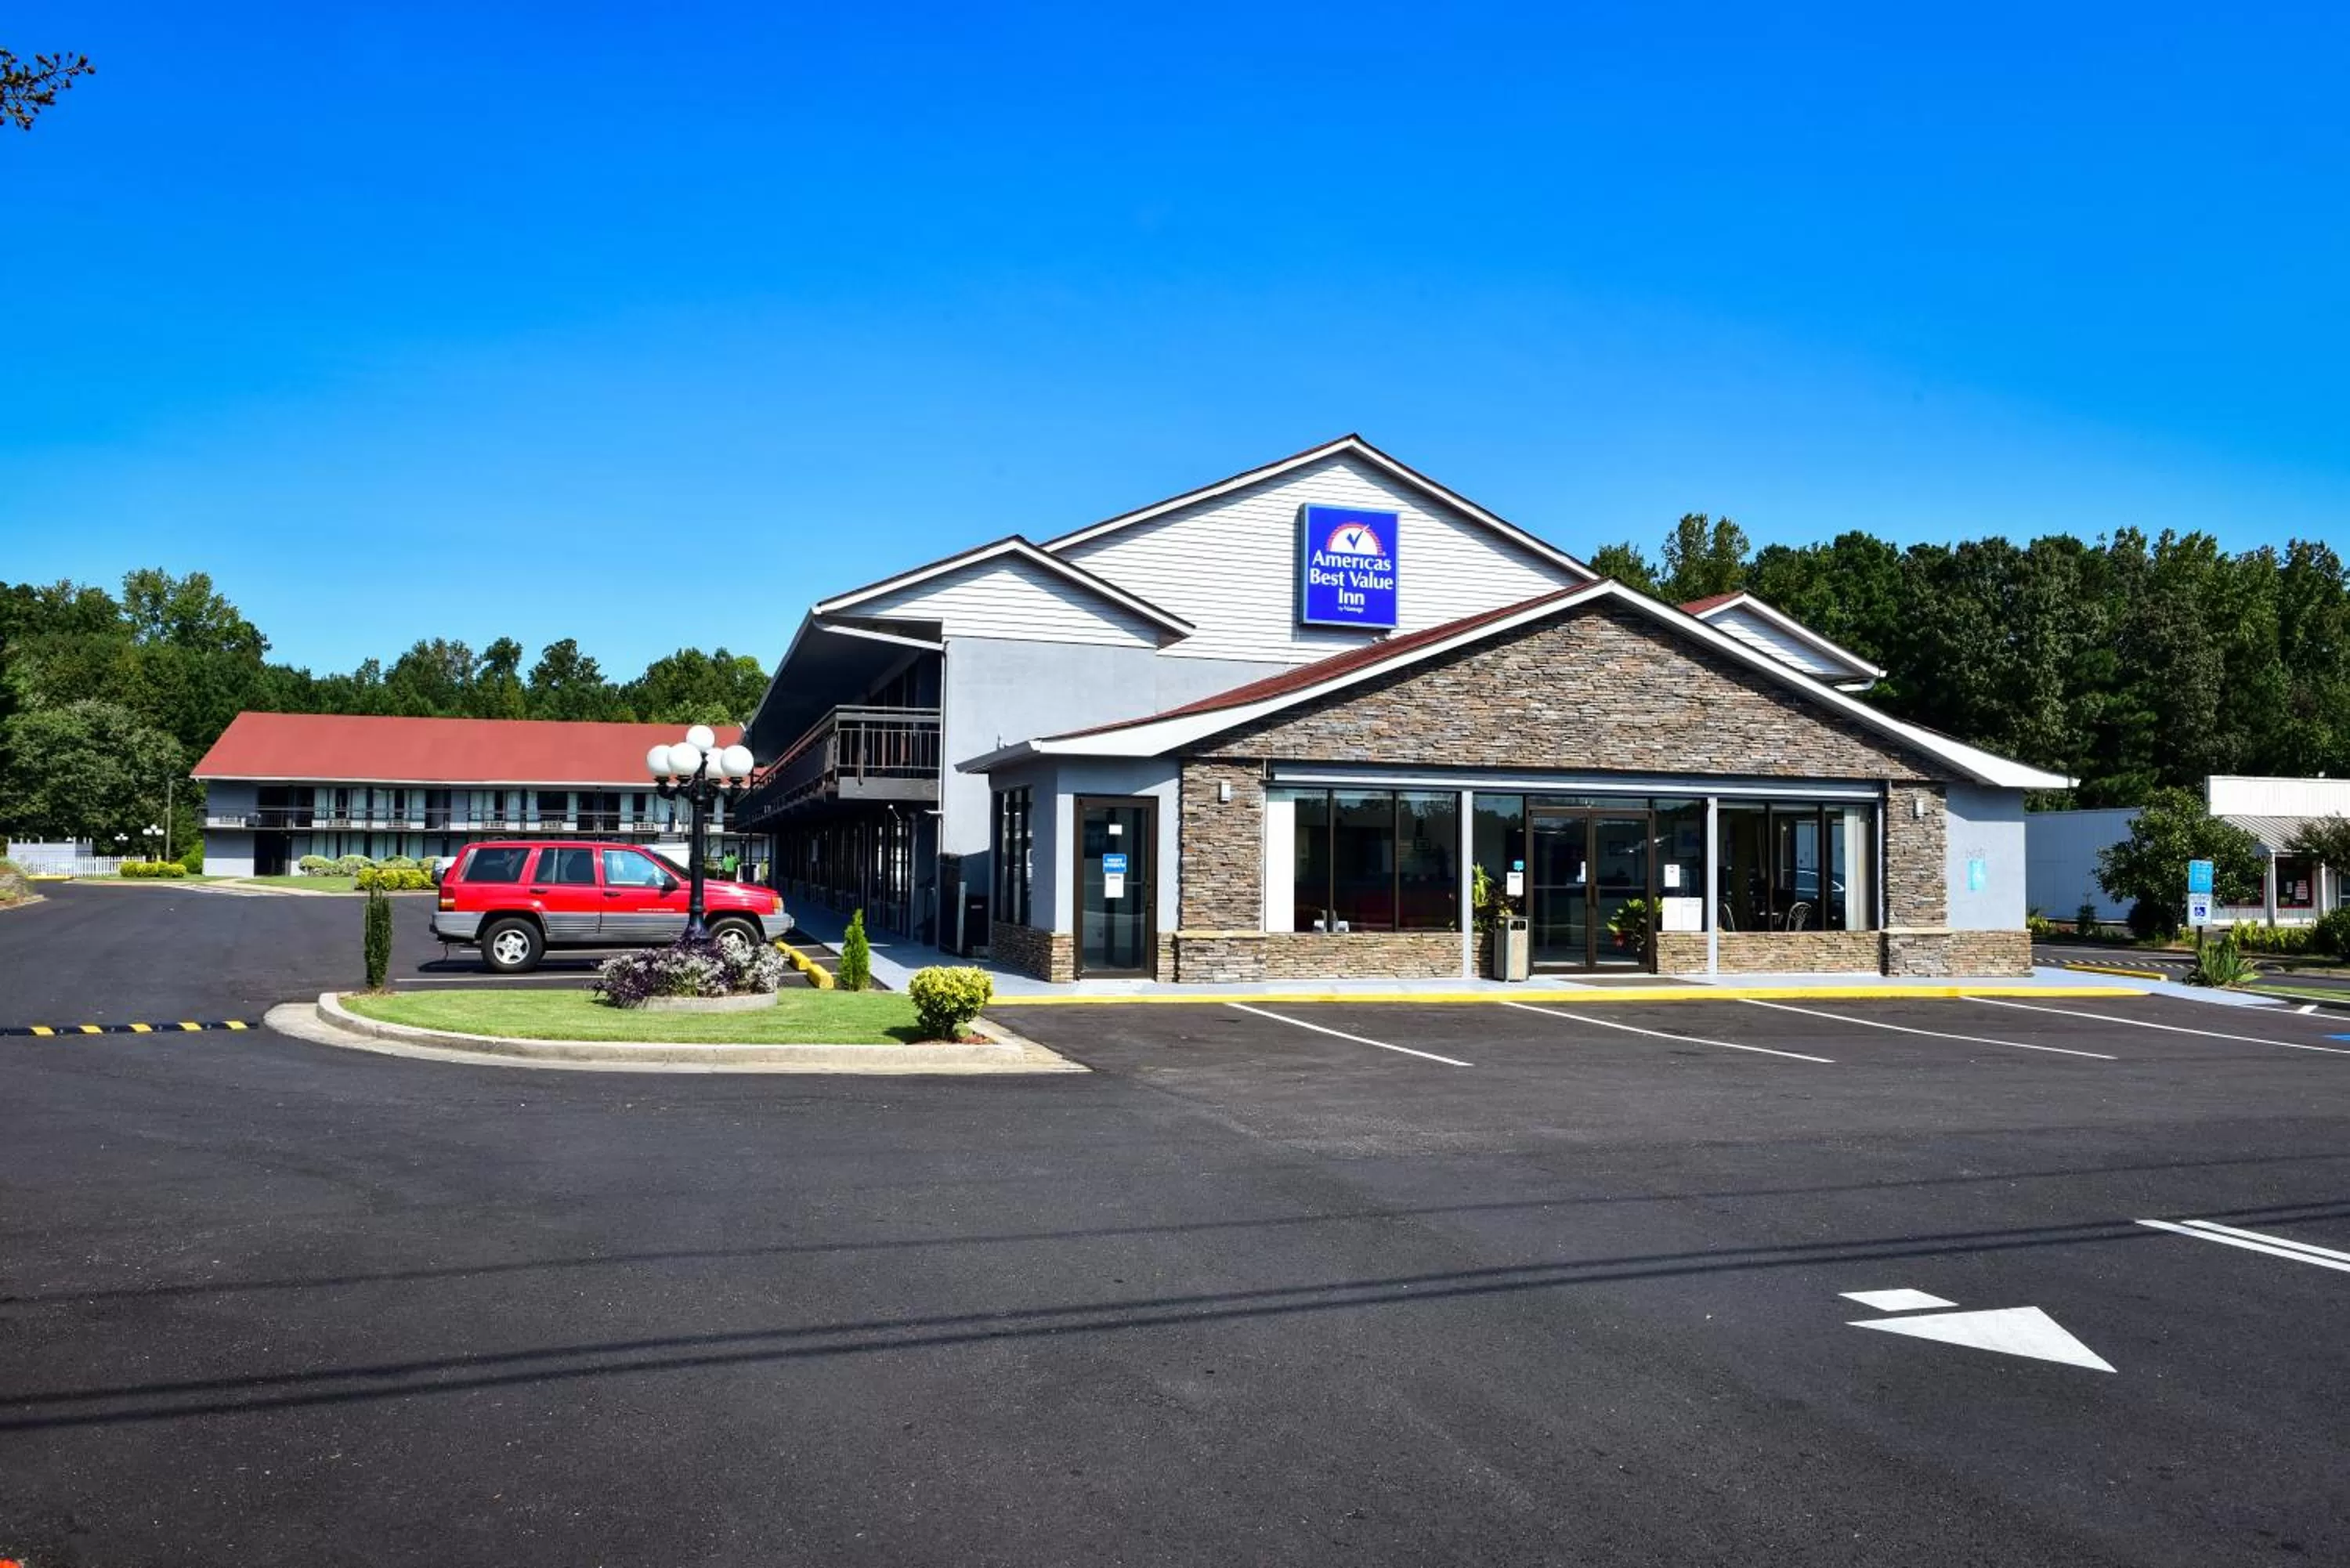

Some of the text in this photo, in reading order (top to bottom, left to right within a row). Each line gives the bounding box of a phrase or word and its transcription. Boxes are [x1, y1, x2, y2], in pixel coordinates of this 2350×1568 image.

[1312, 550, 1391, 571] Americas
[1310, 568, 1394, 590] Best Value
[1338, 588, 1365, 605] Inn
